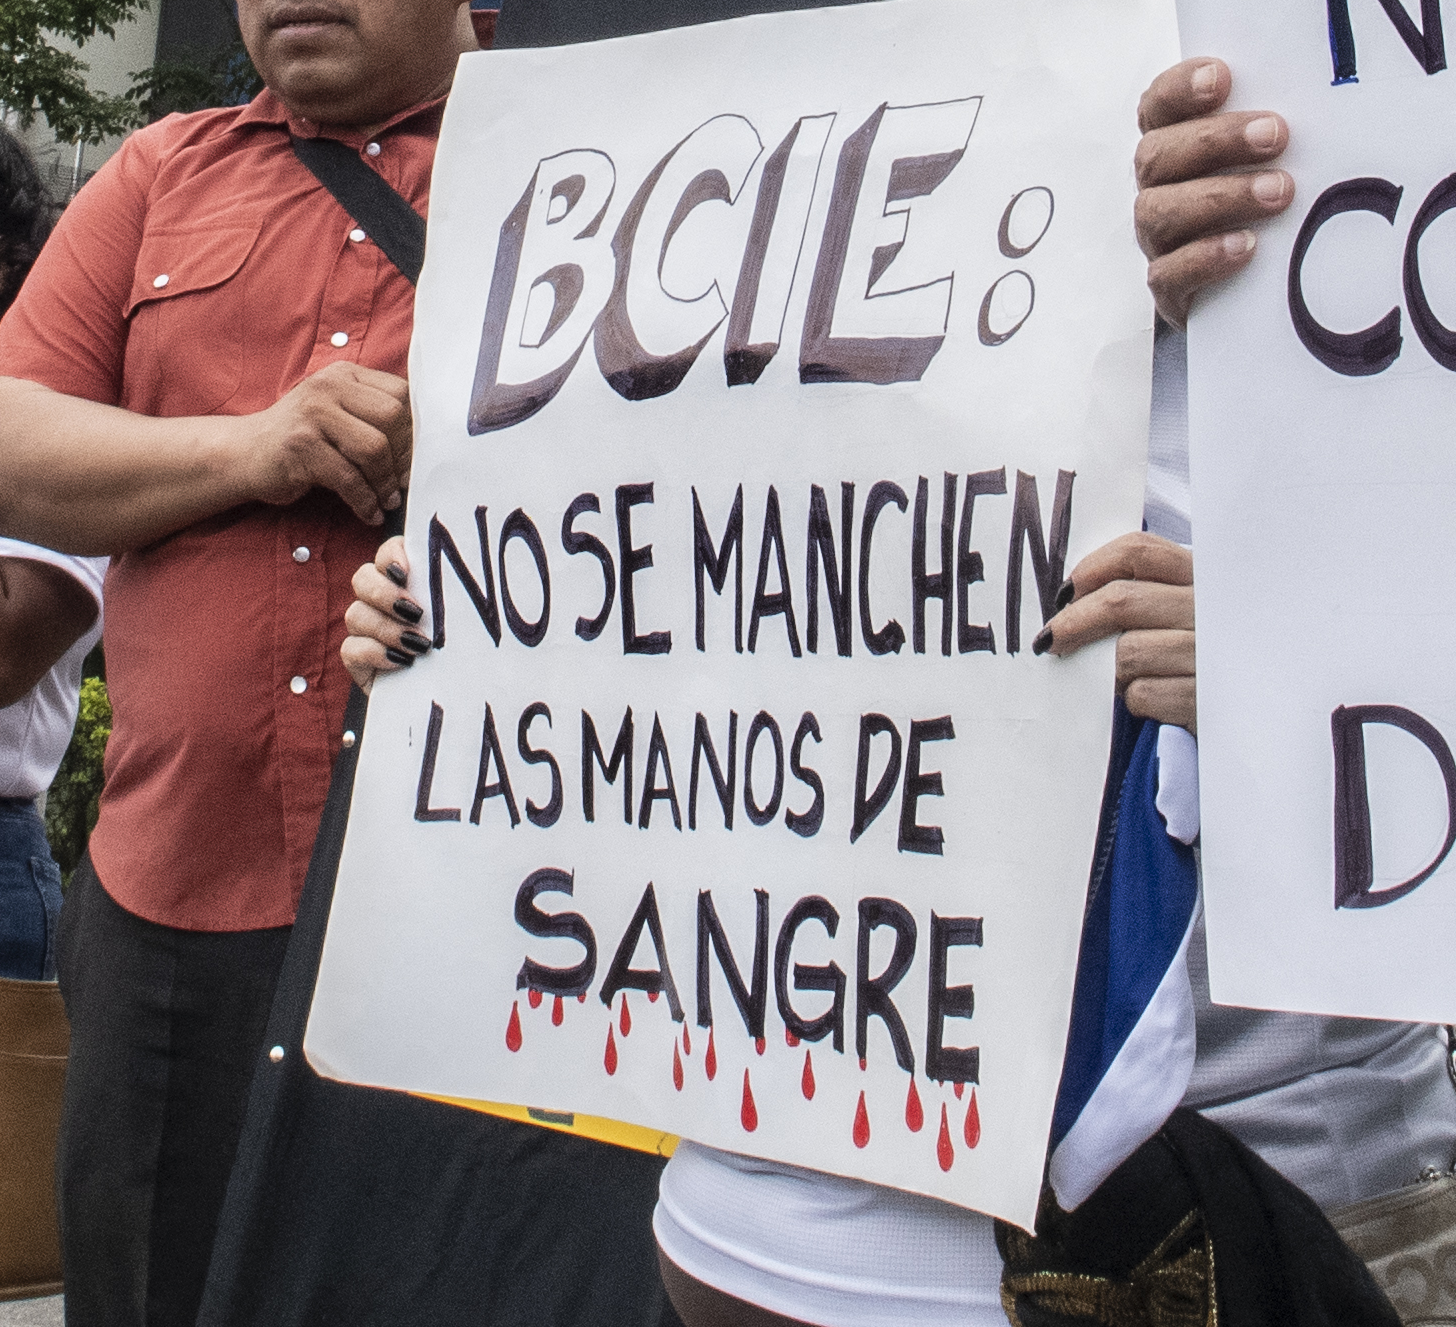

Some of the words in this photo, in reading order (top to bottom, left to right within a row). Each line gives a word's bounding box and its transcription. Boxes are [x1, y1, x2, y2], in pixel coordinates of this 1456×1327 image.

[468, 95, 1055, 436] BCIE:
[429, 504, 547, 650] NO
[561, 482, 672, 654] SE
[692, 466, 1078, 657] MANCHEN
[414, 699, 563, 828] LAS
[581, 704, 825, 839] MANOS
[849, 713, 955, 855] DE
[514, 866, 984, 1084] SANGRE
